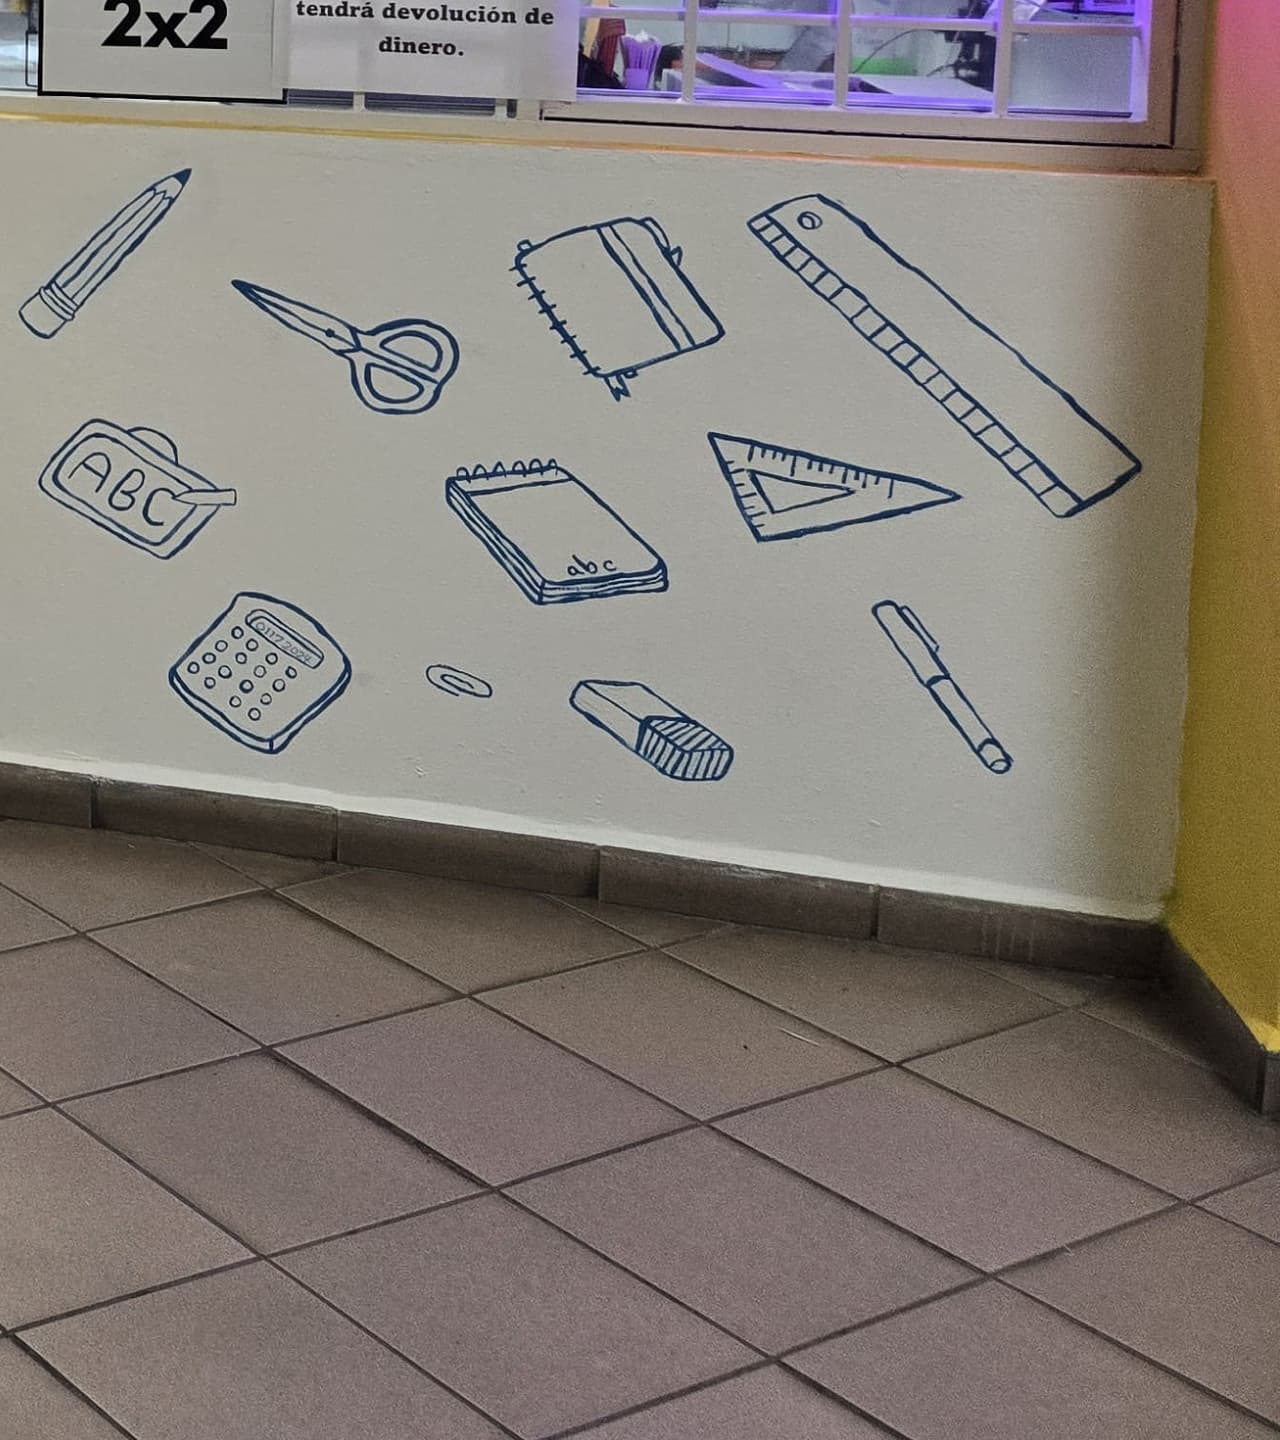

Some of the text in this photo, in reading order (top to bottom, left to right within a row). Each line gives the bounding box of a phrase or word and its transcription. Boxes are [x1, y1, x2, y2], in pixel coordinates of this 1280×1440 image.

[296, 0, 554, 25] tendrá devolución de
[68, 452, 176, 526] ABC
[567, 554, 617, 576] abc
